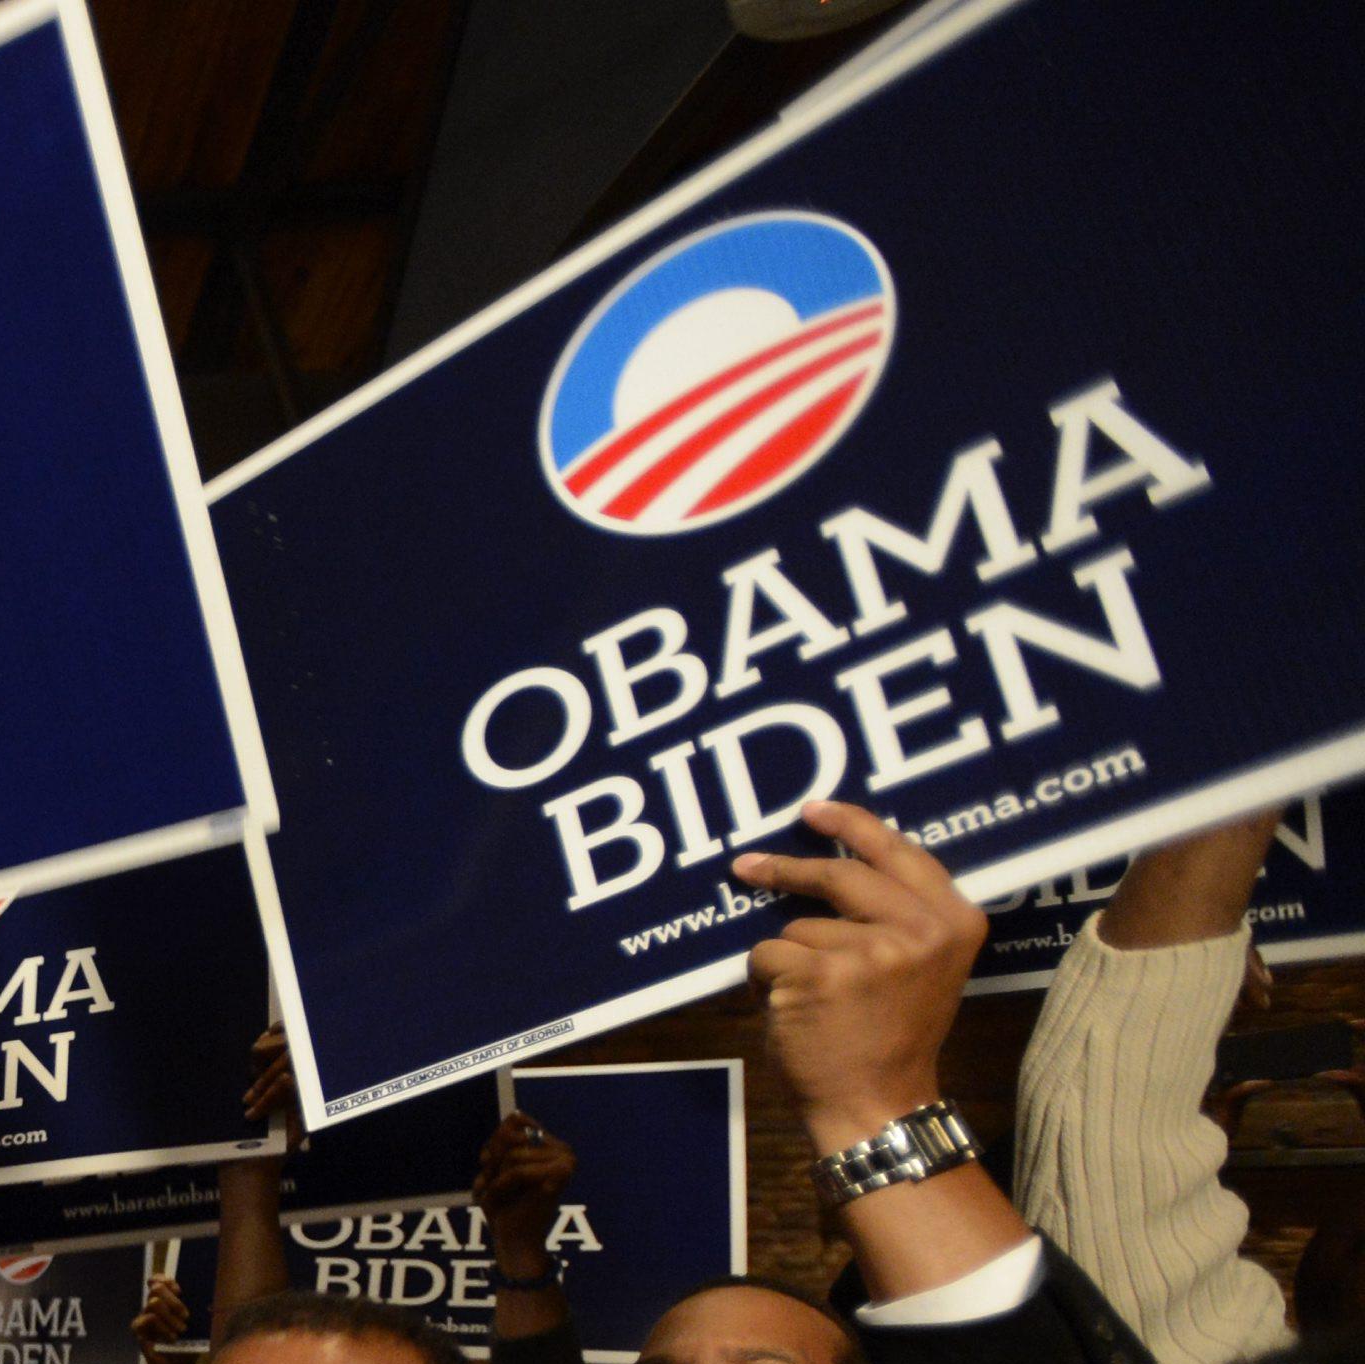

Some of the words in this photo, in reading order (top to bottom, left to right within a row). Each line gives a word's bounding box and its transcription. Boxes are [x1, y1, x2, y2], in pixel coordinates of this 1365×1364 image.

[461, 378, 1211, 790] OBAMA
[541, 547, 1164, 913] BIDEN
[327, 1100, 349, 1116] PAID
[350, 1094, 370, 1107] FOR
[371, 1088, 384, 1100] BY
[385, 1082, 405, 1094] THE
[406, 1058, 471, 1087] DEMOCRATIC
[471, 1045, 504, 1063] PARTY
[506, 1039, 521, 1051] OF
[522, 1021, 572, 1045] GEORGIA
[314, 1256, 498, 1308] BIDE
